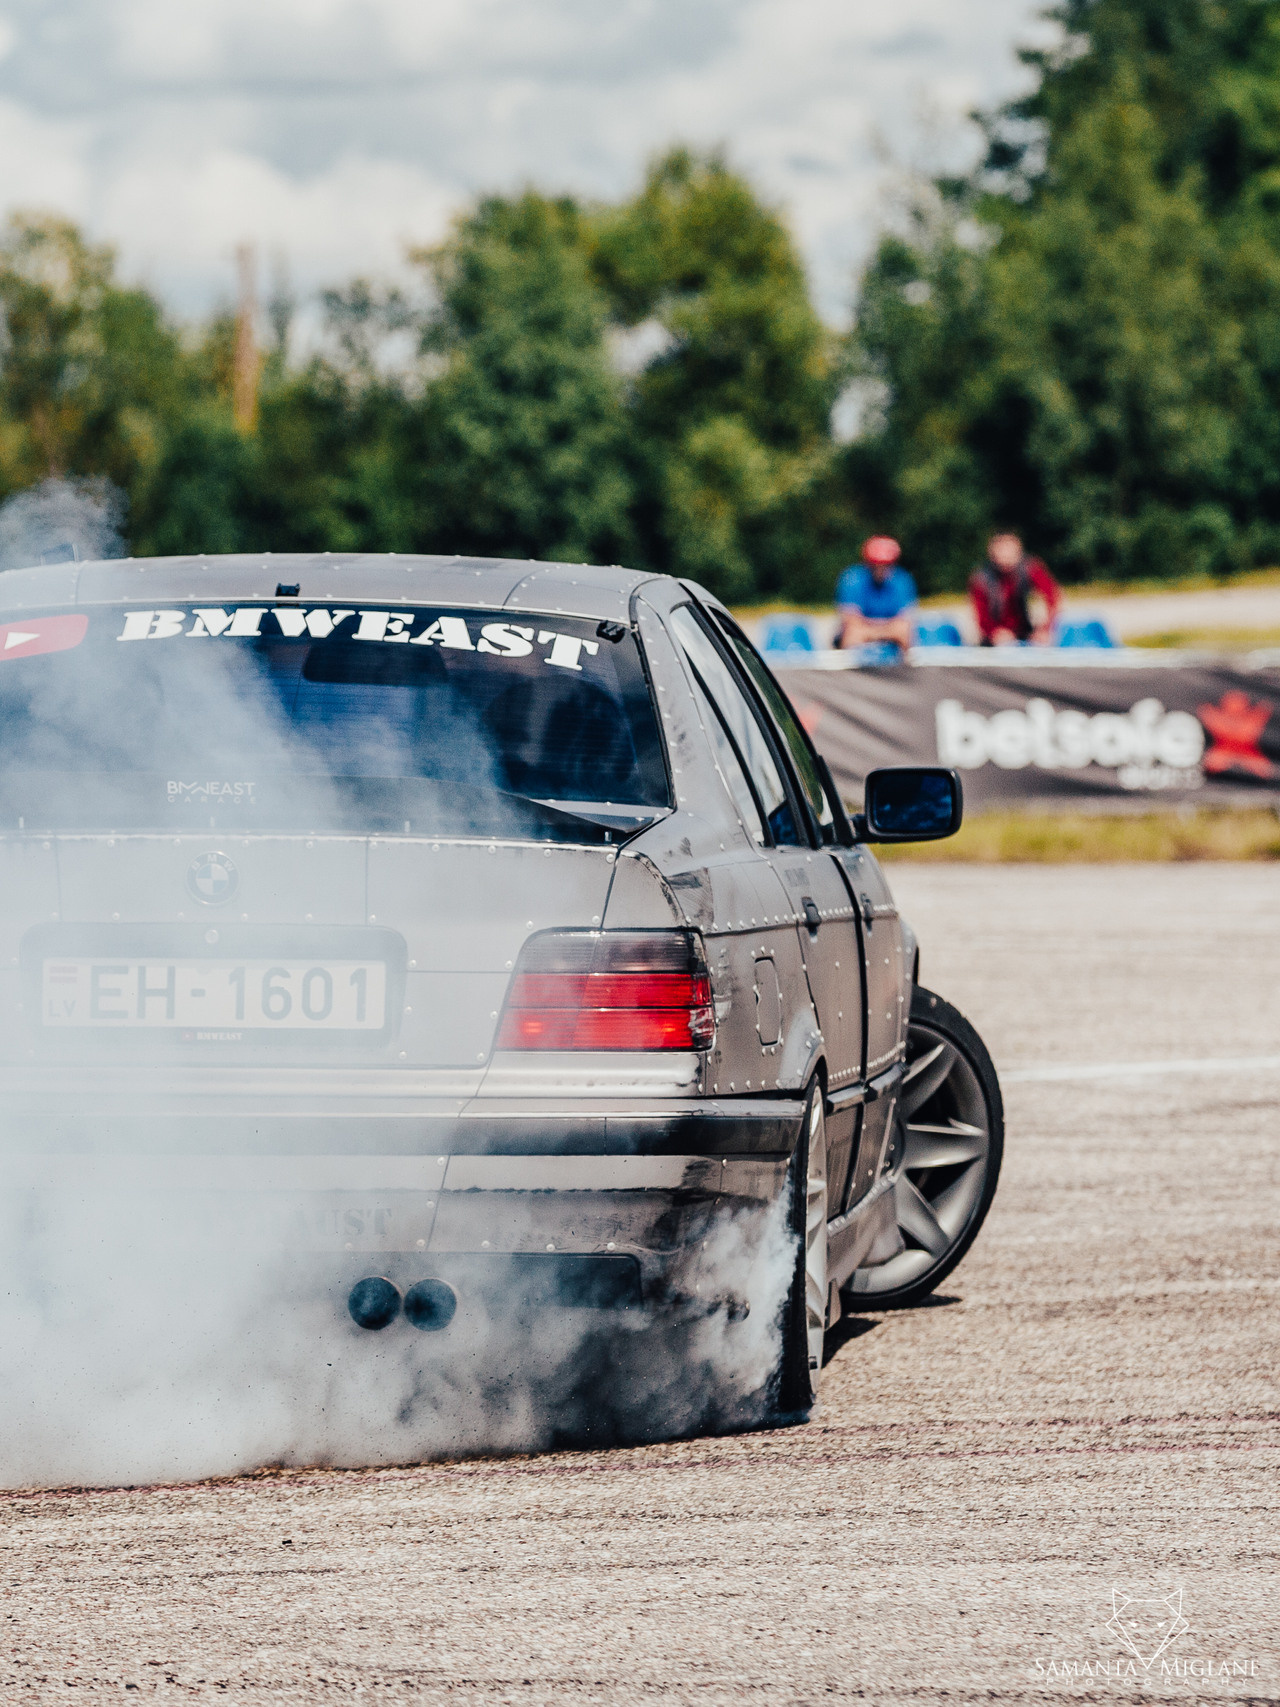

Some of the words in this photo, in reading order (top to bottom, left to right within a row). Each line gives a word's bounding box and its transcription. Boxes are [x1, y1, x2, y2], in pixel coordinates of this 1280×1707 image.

[117, 608, 599, 671] BMWEAST
[167, 781, 255, 795] BMWEAST
[167, 795, 256, 804] GARAGE
[191, 854, 235, 872] BMW
[49, 999, 77, 1017] LV
